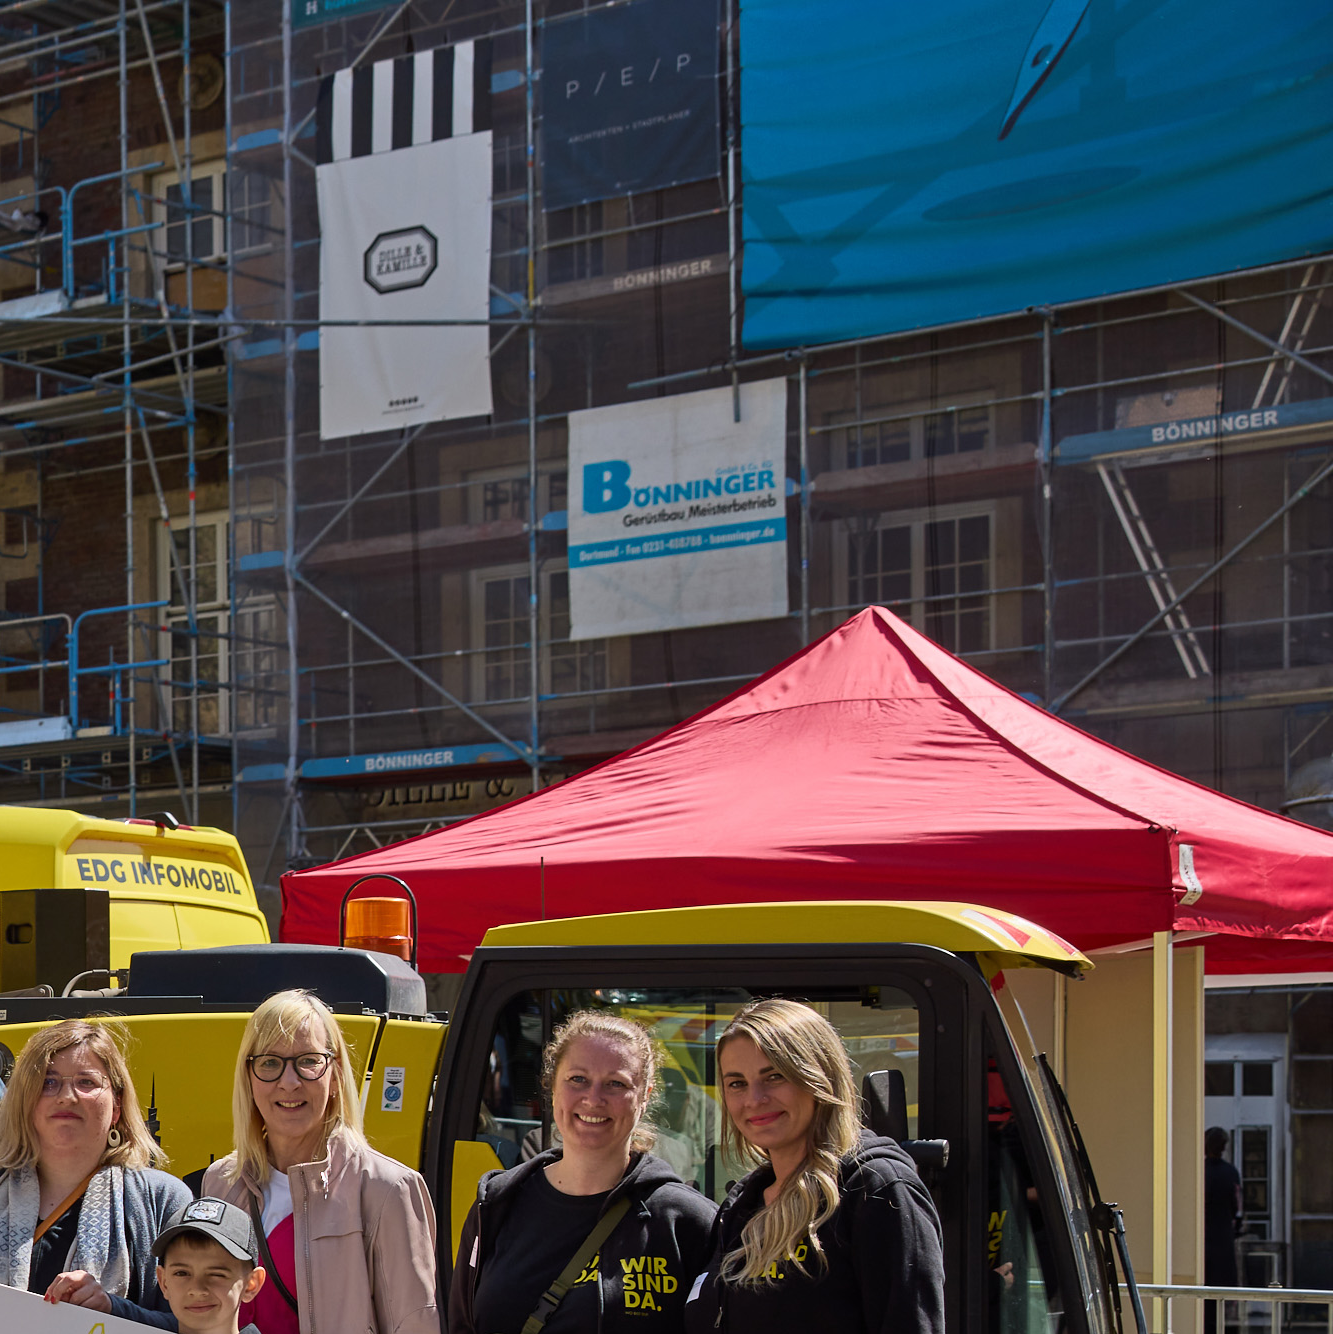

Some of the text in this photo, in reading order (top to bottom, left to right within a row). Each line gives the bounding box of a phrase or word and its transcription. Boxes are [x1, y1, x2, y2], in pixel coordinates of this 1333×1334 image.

[566, 80, 580, 99] P
[621, 66, 634, 87] E
[676, 53, 691, 72] P
[1151, 409, 1279, 443] BÖNNINGER
[583, 460, 775, 514] BÖNNINGER
[365, 750, 454, 772] BÖNNINGER
[77, 856, 241, 896] EDG INFOMOBIL
[620, 1256, 668, 1275] WIR
[622, 1273, 678, 1294] SIND
[624, 1291, 662, 1312] DA.
